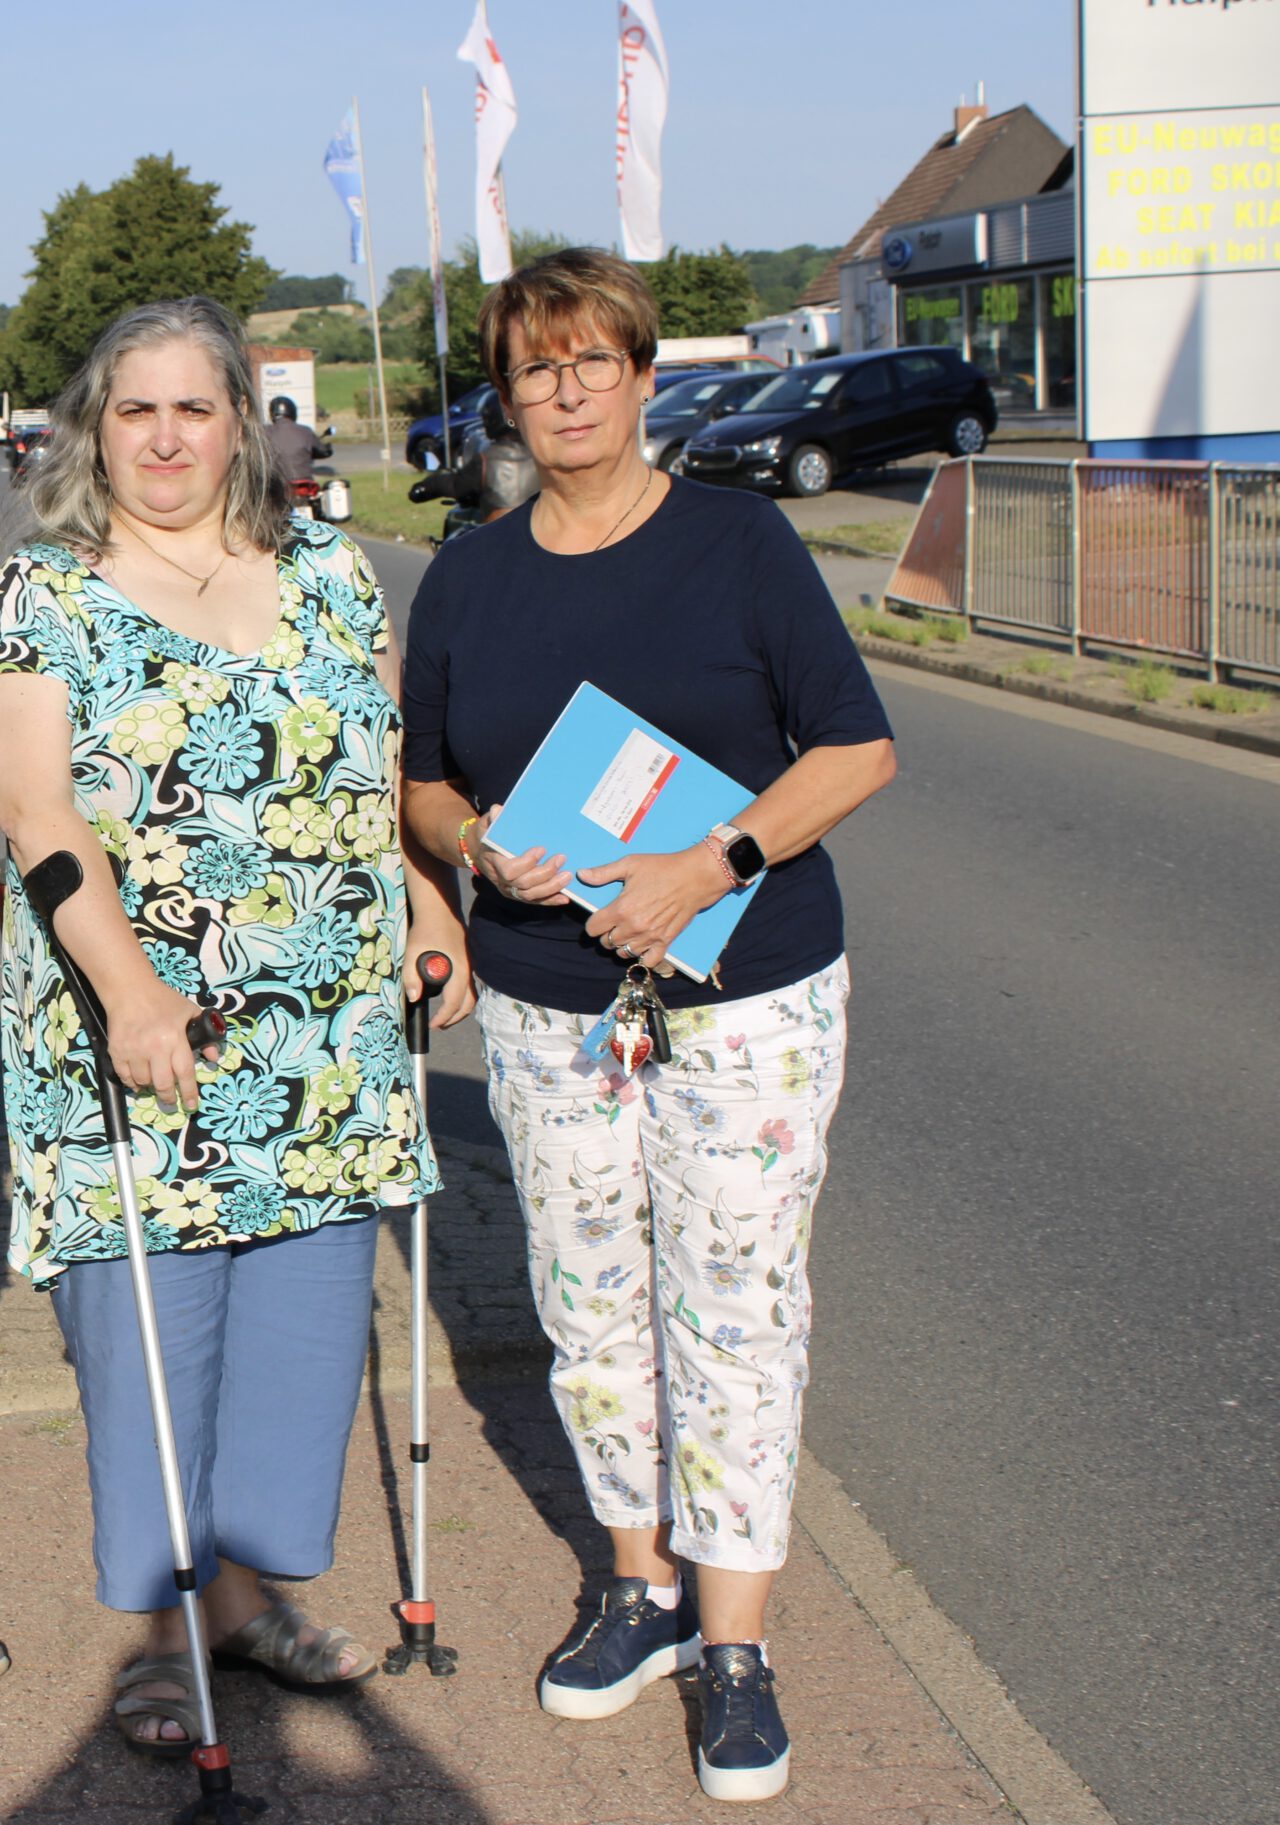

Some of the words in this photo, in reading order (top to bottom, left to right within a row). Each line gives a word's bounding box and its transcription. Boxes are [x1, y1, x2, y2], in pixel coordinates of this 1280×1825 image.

[1107, 165, 1192, 198] FORD
[1210, 161, 1280, 193] SKO
[1136, 203, 1216, 235] SEAT
[1096, 245, 1129, 270] Ab
[1138, 241, 1217, 268] sofort
[1225, 236, 1266, 263] bei
